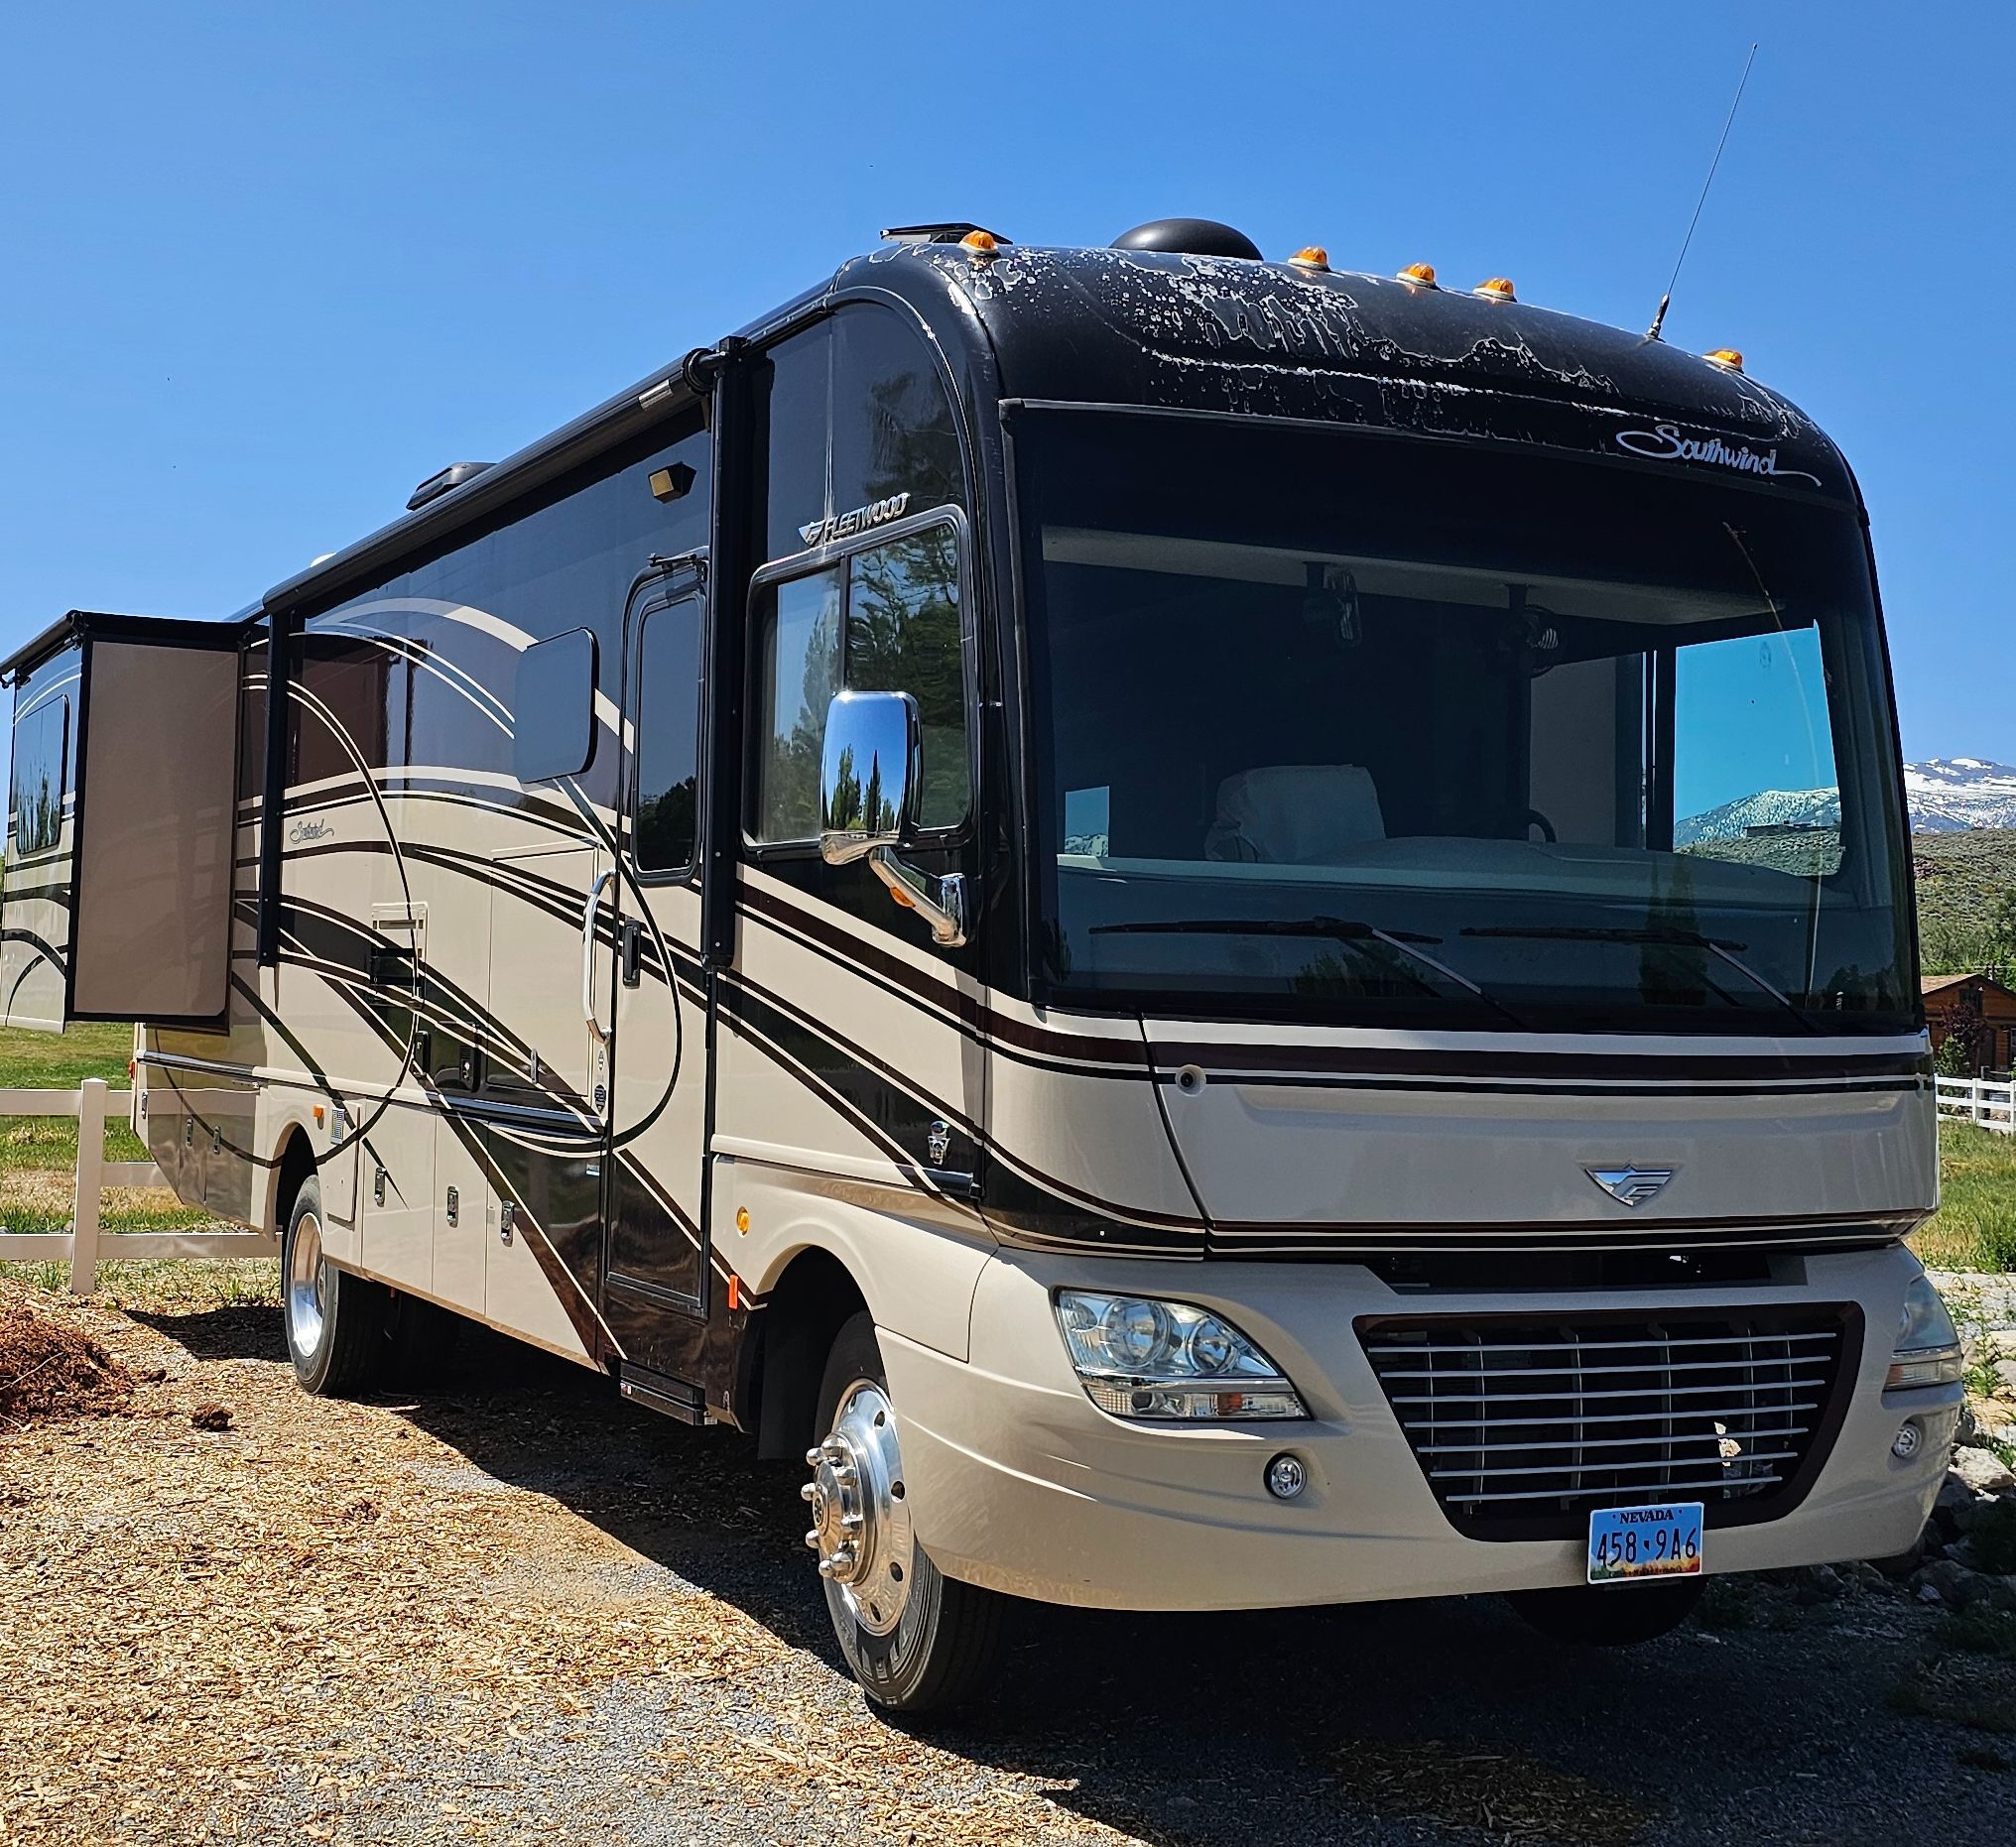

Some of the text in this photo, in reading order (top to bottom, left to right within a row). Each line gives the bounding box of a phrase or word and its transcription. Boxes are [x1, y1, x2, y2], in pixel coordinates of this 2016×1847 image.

[1615, 425, 1823, 487] Southwind
[823, 492, 911, 543] FLEETWOOD
[1619, 1509, 1675, 1524] NEVADA
